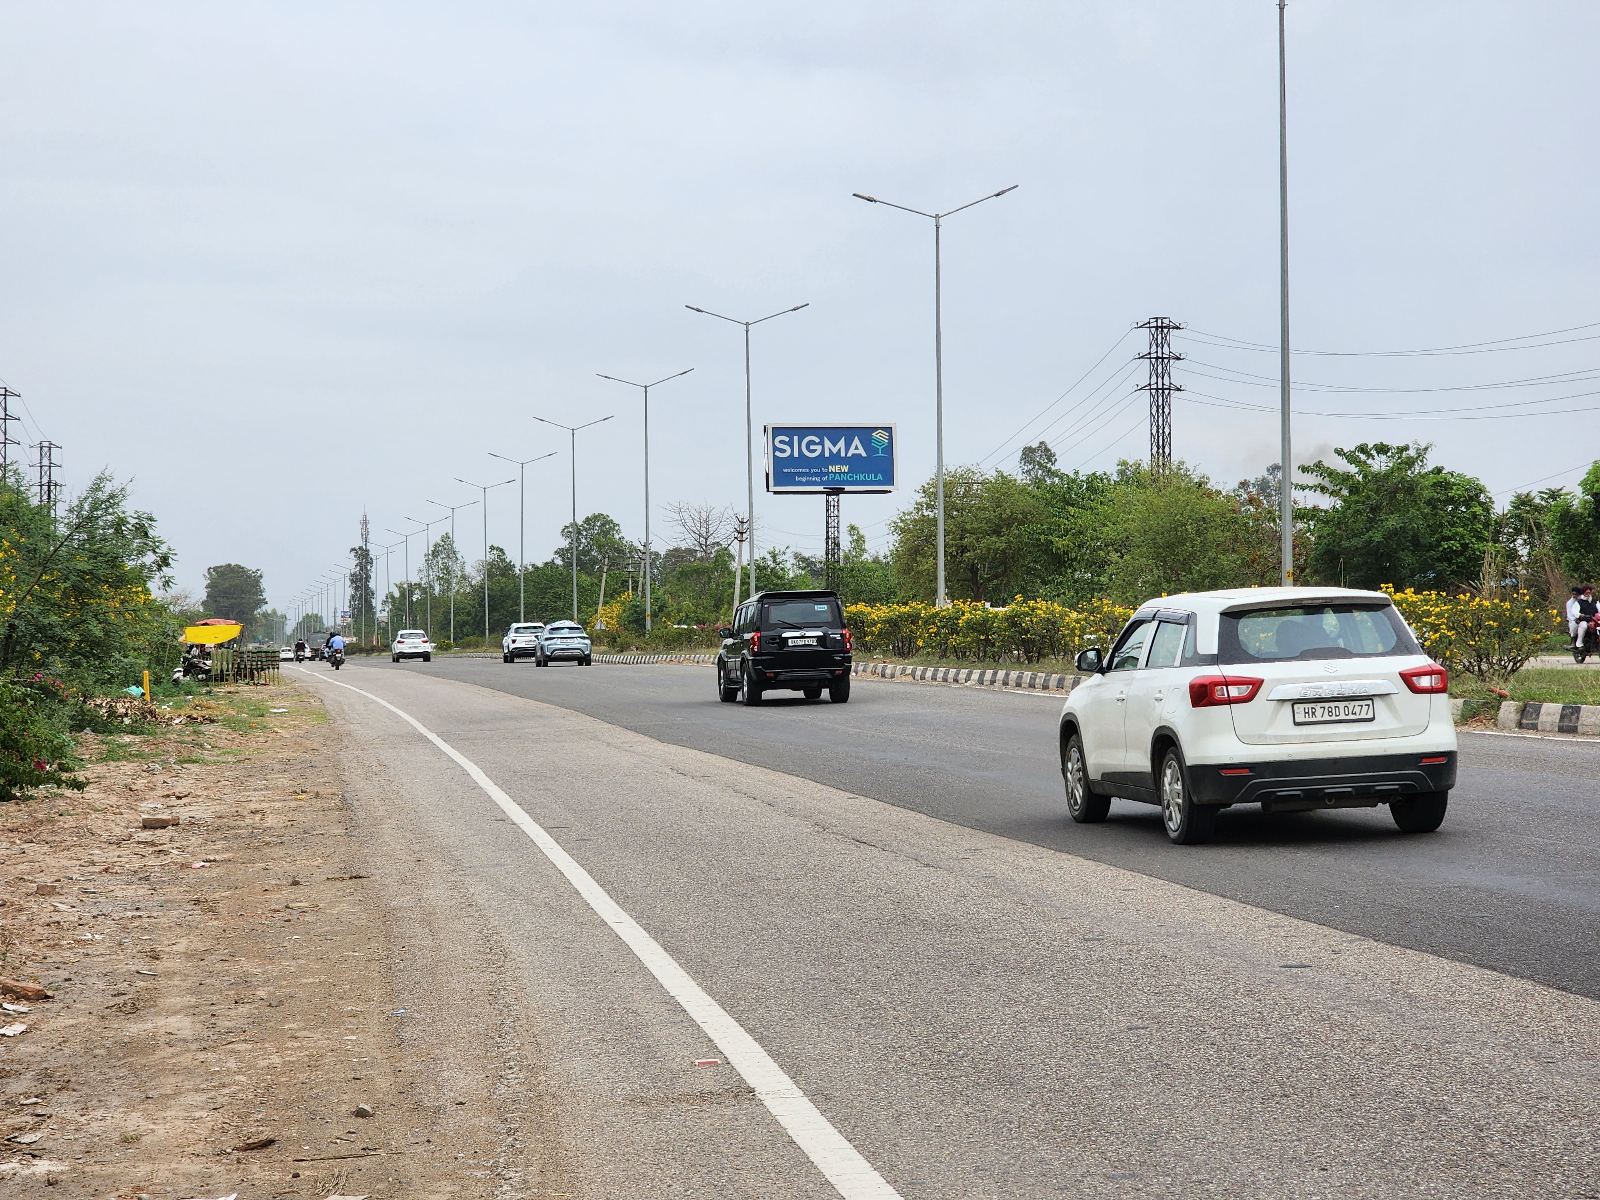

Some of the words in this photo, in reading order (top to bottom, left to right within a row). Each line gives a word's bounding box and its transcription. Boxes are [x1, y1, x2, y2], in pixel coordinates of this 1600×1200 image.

[774, 435, 867, 458] SIGMA
[828, 465, 849, 473] NEW
[829, 473, 883, 481] PANCHKULA
[1303, 706, 1317, 719] HR
[1320, 705, 1341, 717] 78D
[1343, 703, 1371, 717] 0477
